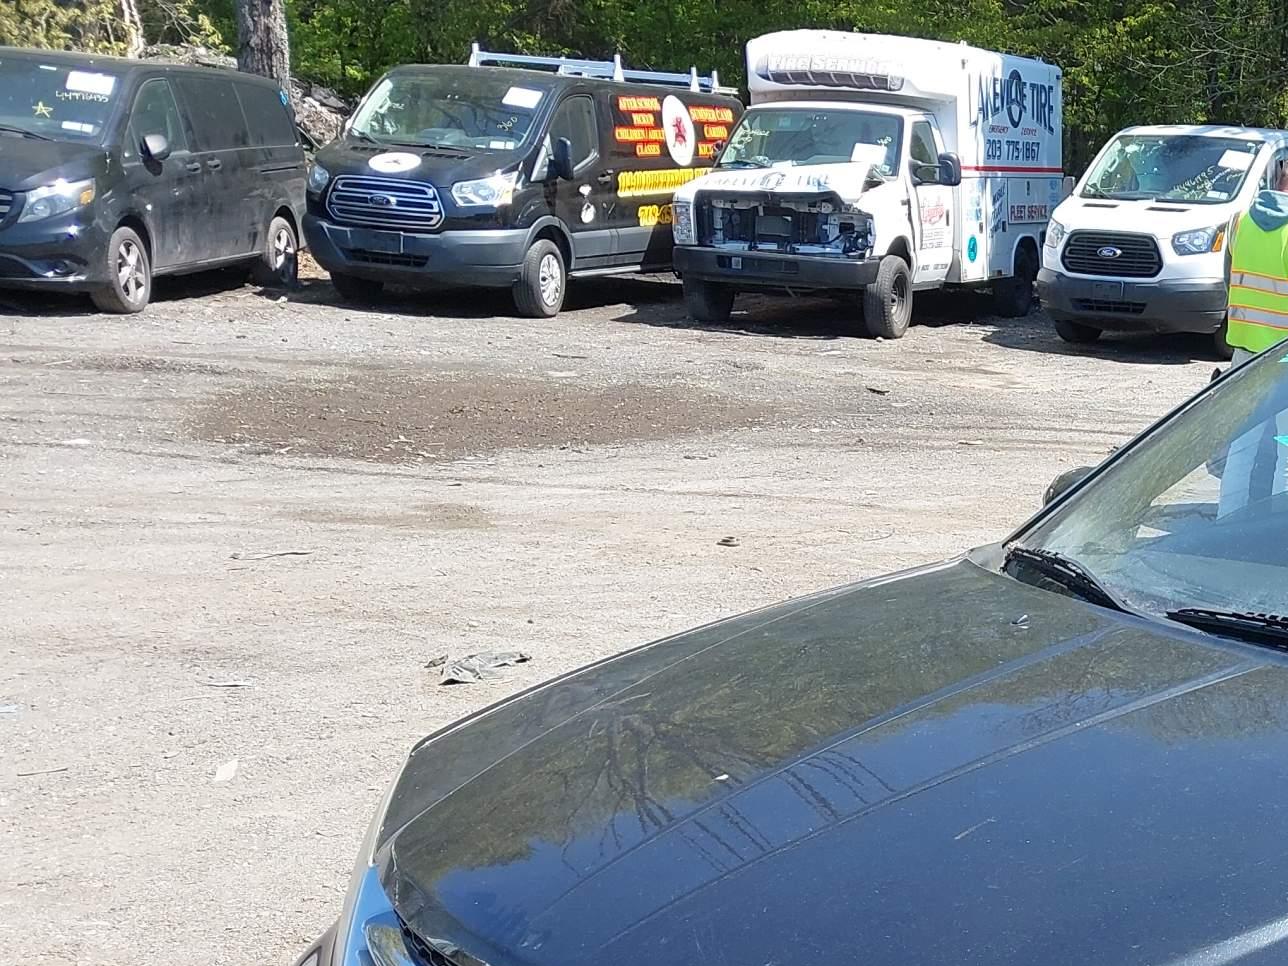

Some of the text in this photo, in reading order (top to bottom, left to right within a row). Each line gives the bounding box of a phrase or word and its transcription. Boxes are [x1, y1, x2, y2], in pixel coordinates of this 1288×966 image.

[1029, 82, 1054, 134] TIRE
[986, 139, 1001, 160] 203
[1010, 205, 1026, 221] FLEET
